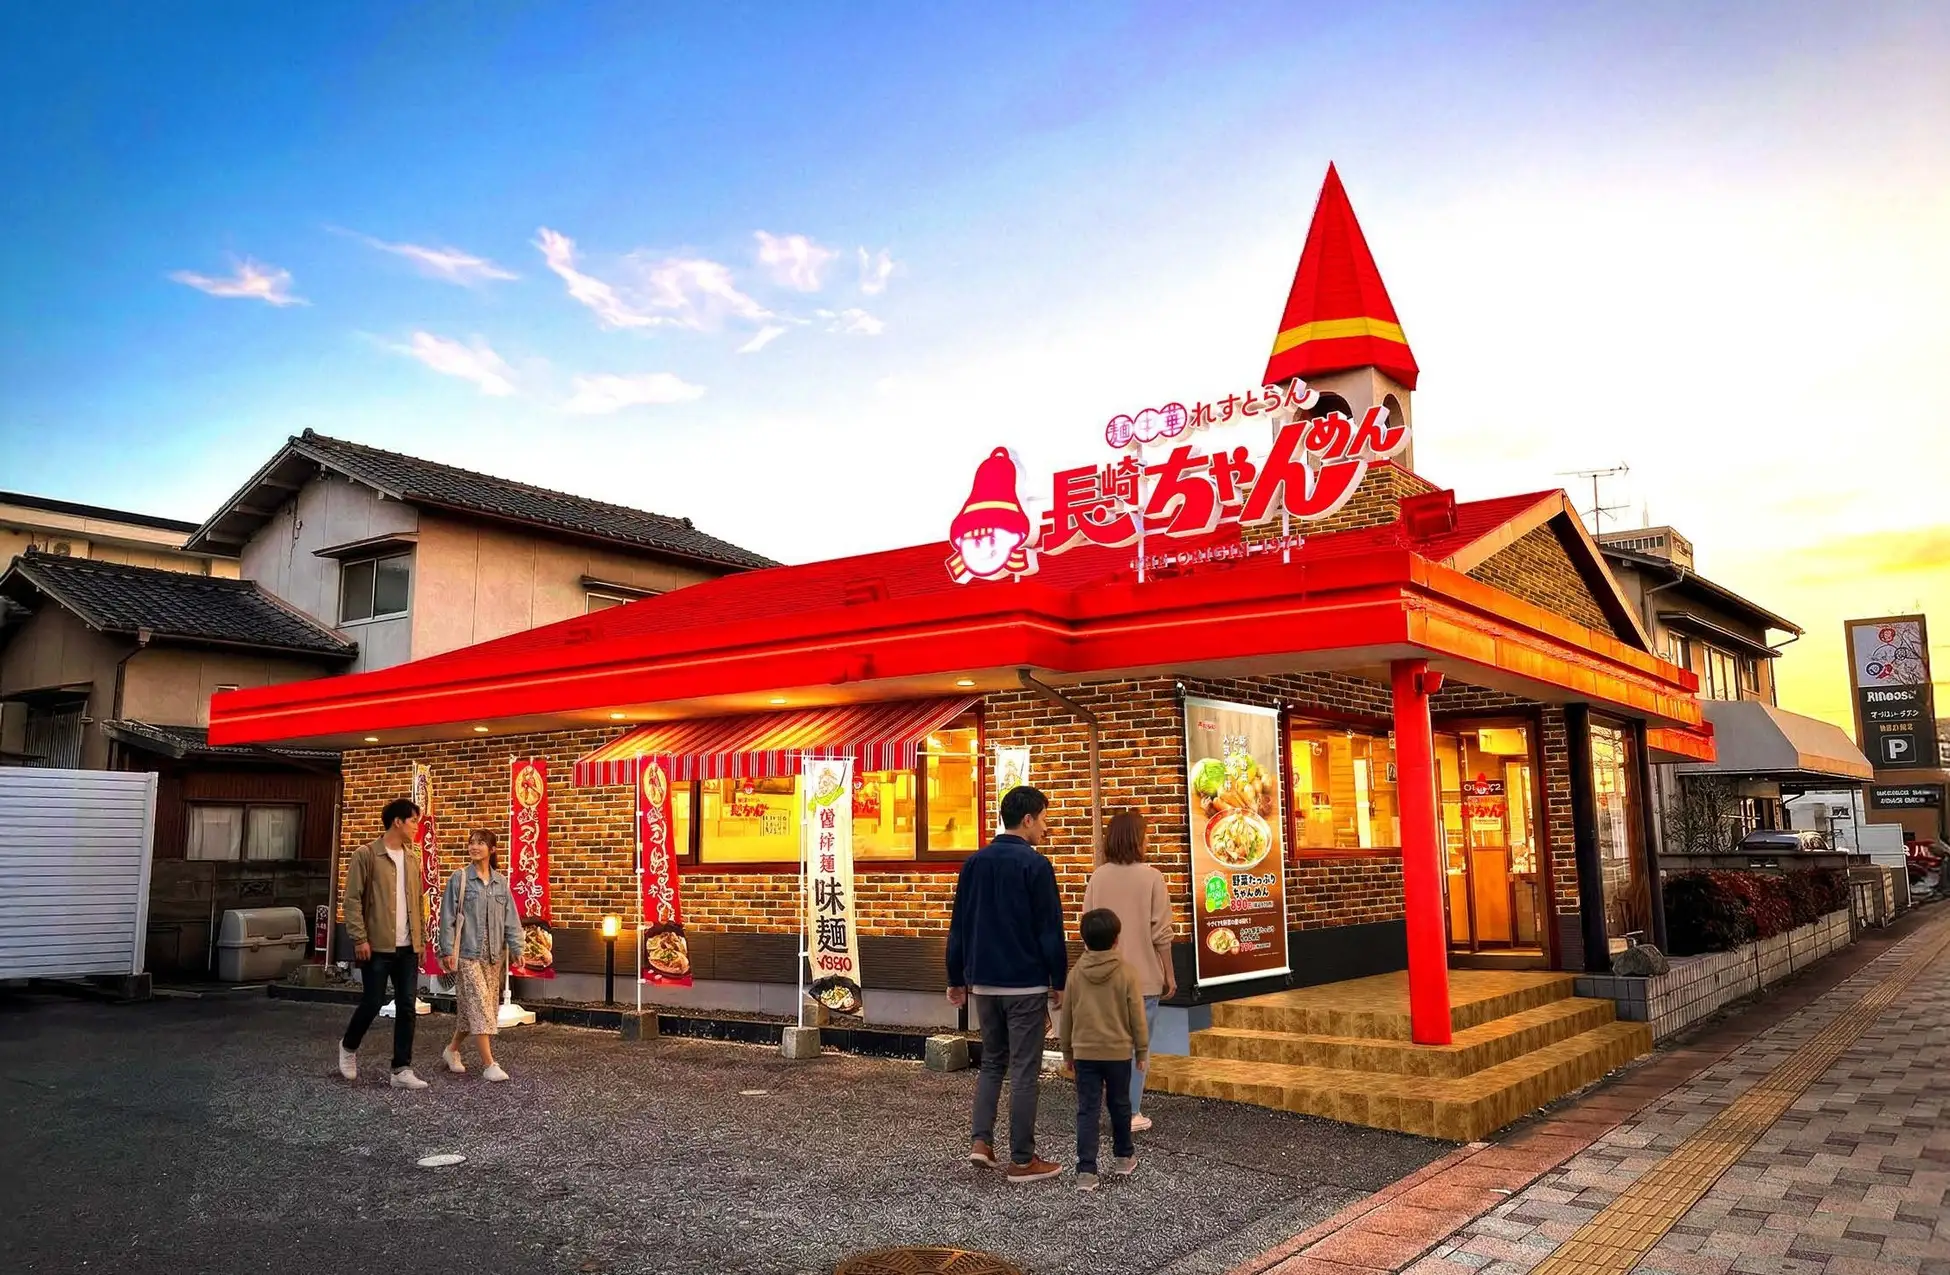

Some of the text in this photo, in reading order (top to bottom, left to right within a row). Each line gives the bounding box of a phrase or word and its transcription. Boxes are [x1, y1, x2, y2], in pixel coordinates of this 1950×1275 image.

[1039, 405, 1405, 553] 長崎ちゃんめん
[1888, 738, 1908, 759] P
[1233, 887, 1270, 899] ちゃんめん
